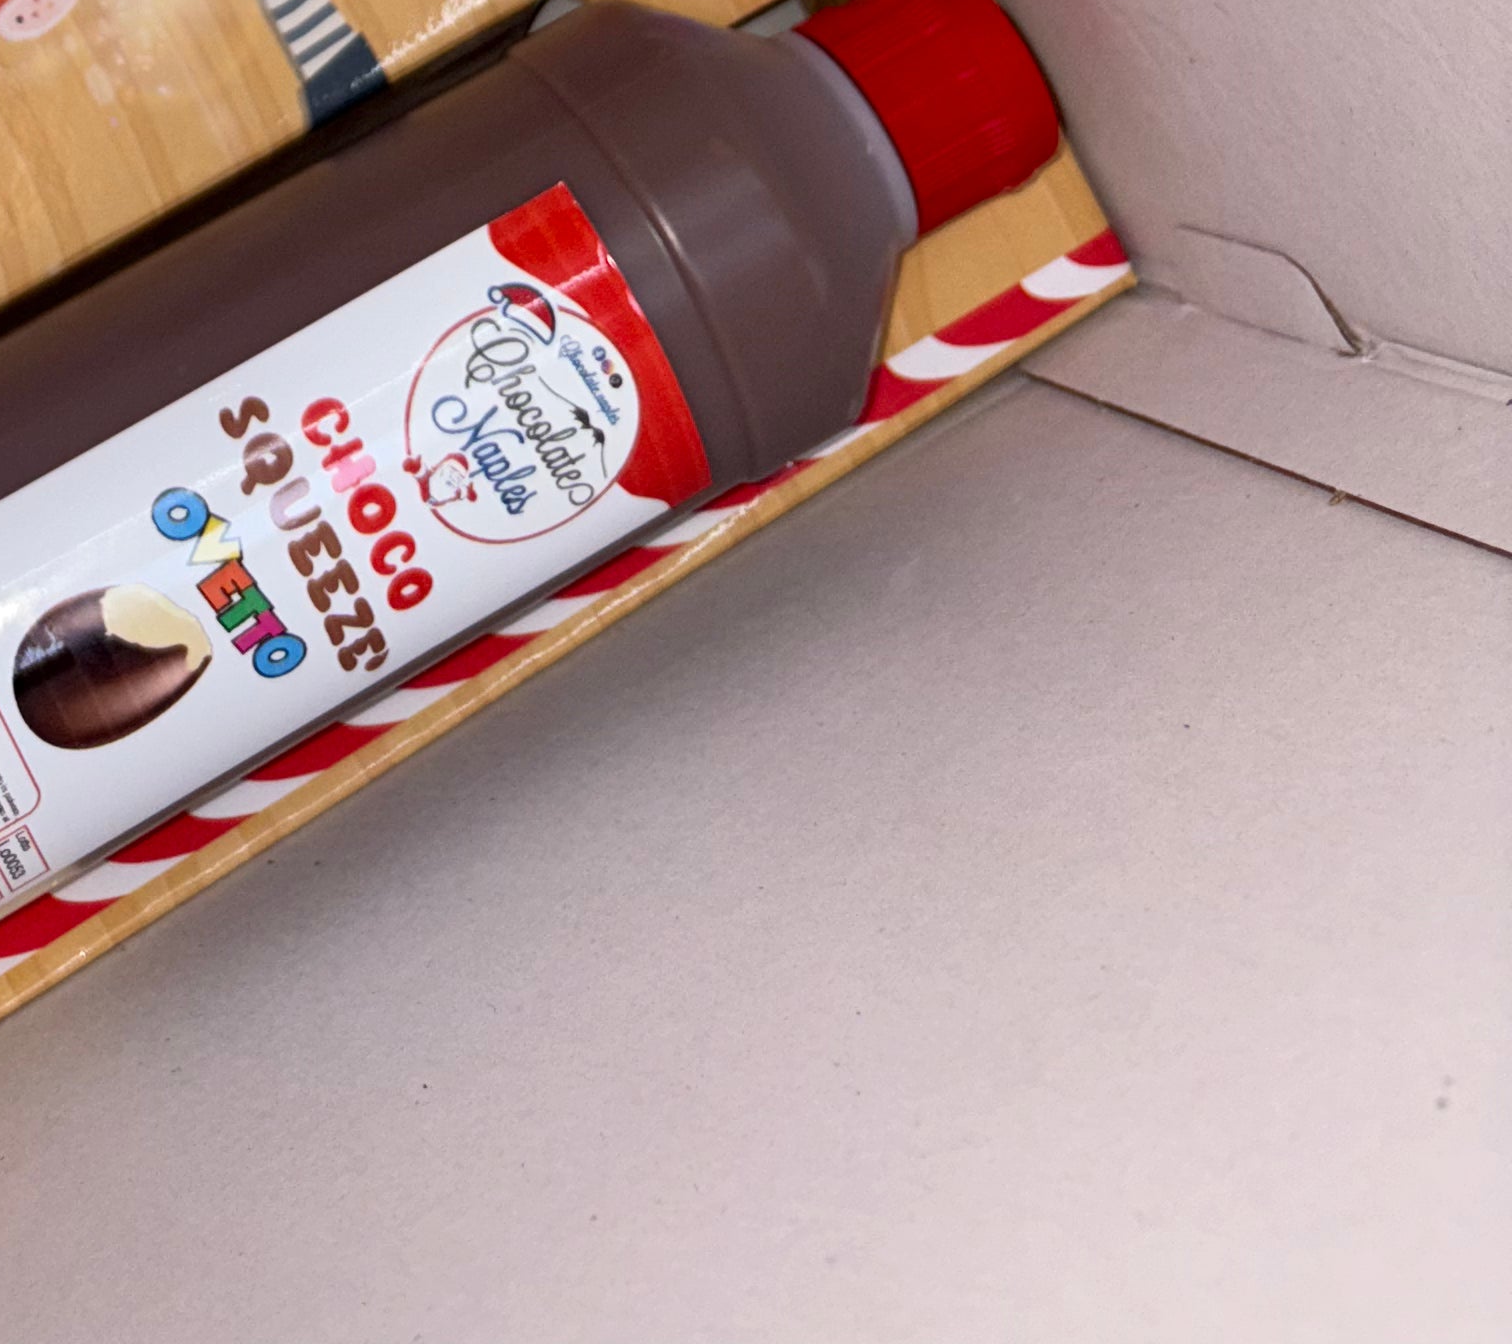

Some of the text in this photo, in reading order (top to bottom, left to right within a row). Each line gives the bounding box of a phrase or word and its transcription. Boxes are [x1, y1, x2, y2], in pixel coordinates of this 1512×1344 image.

[298, 394, 439, 612] CHOCO
[431, 398, 536, 520] Naples
[465, 320, 593, 503] Chocolate
[150, 489, 305, 676] OVETTO
